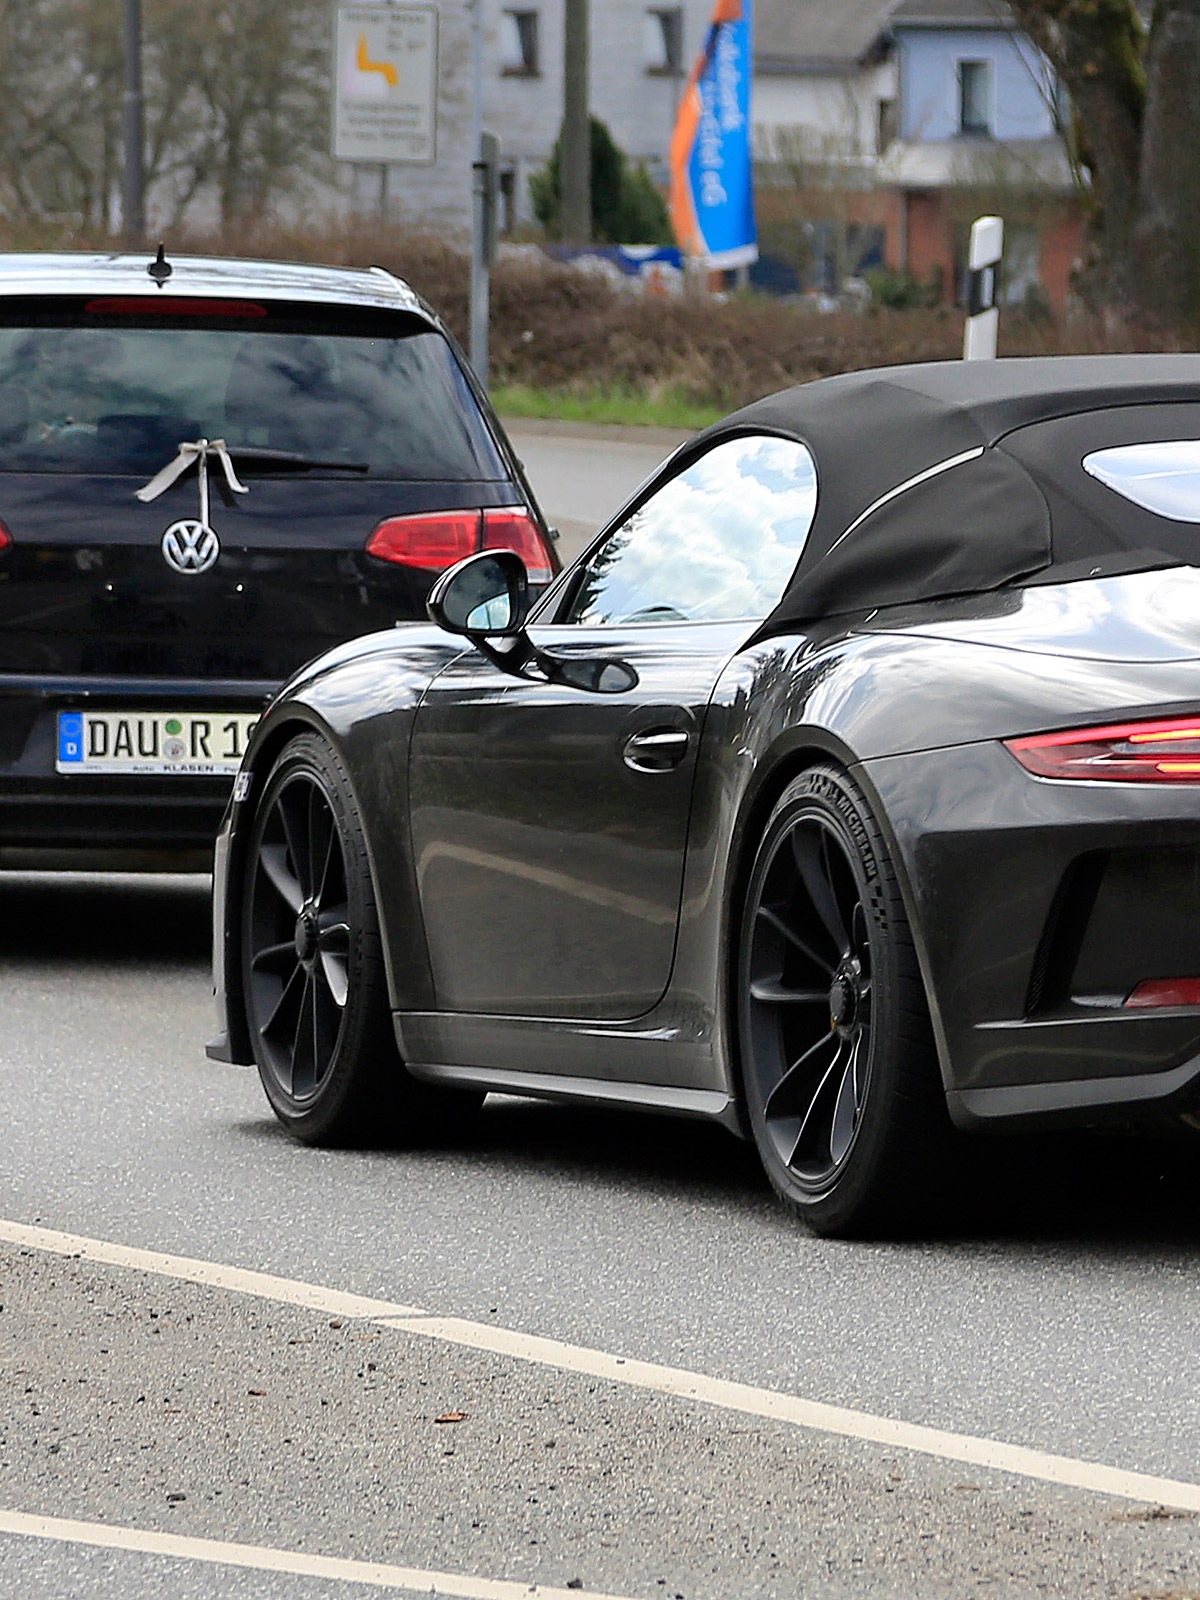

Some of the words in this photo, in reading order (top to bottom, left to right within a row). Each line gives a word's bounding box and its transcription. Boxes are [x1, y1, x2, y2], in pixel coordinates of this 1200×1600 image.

[164, 521, 218, 571] VW
[67, 742, 78, 755] D
[88, 719, 160, 758] DAU
[190, 719, 212, 758] R
[163, 764, 214, 773] KLASEN
[837, 793, 878, 880] MICHELIN
